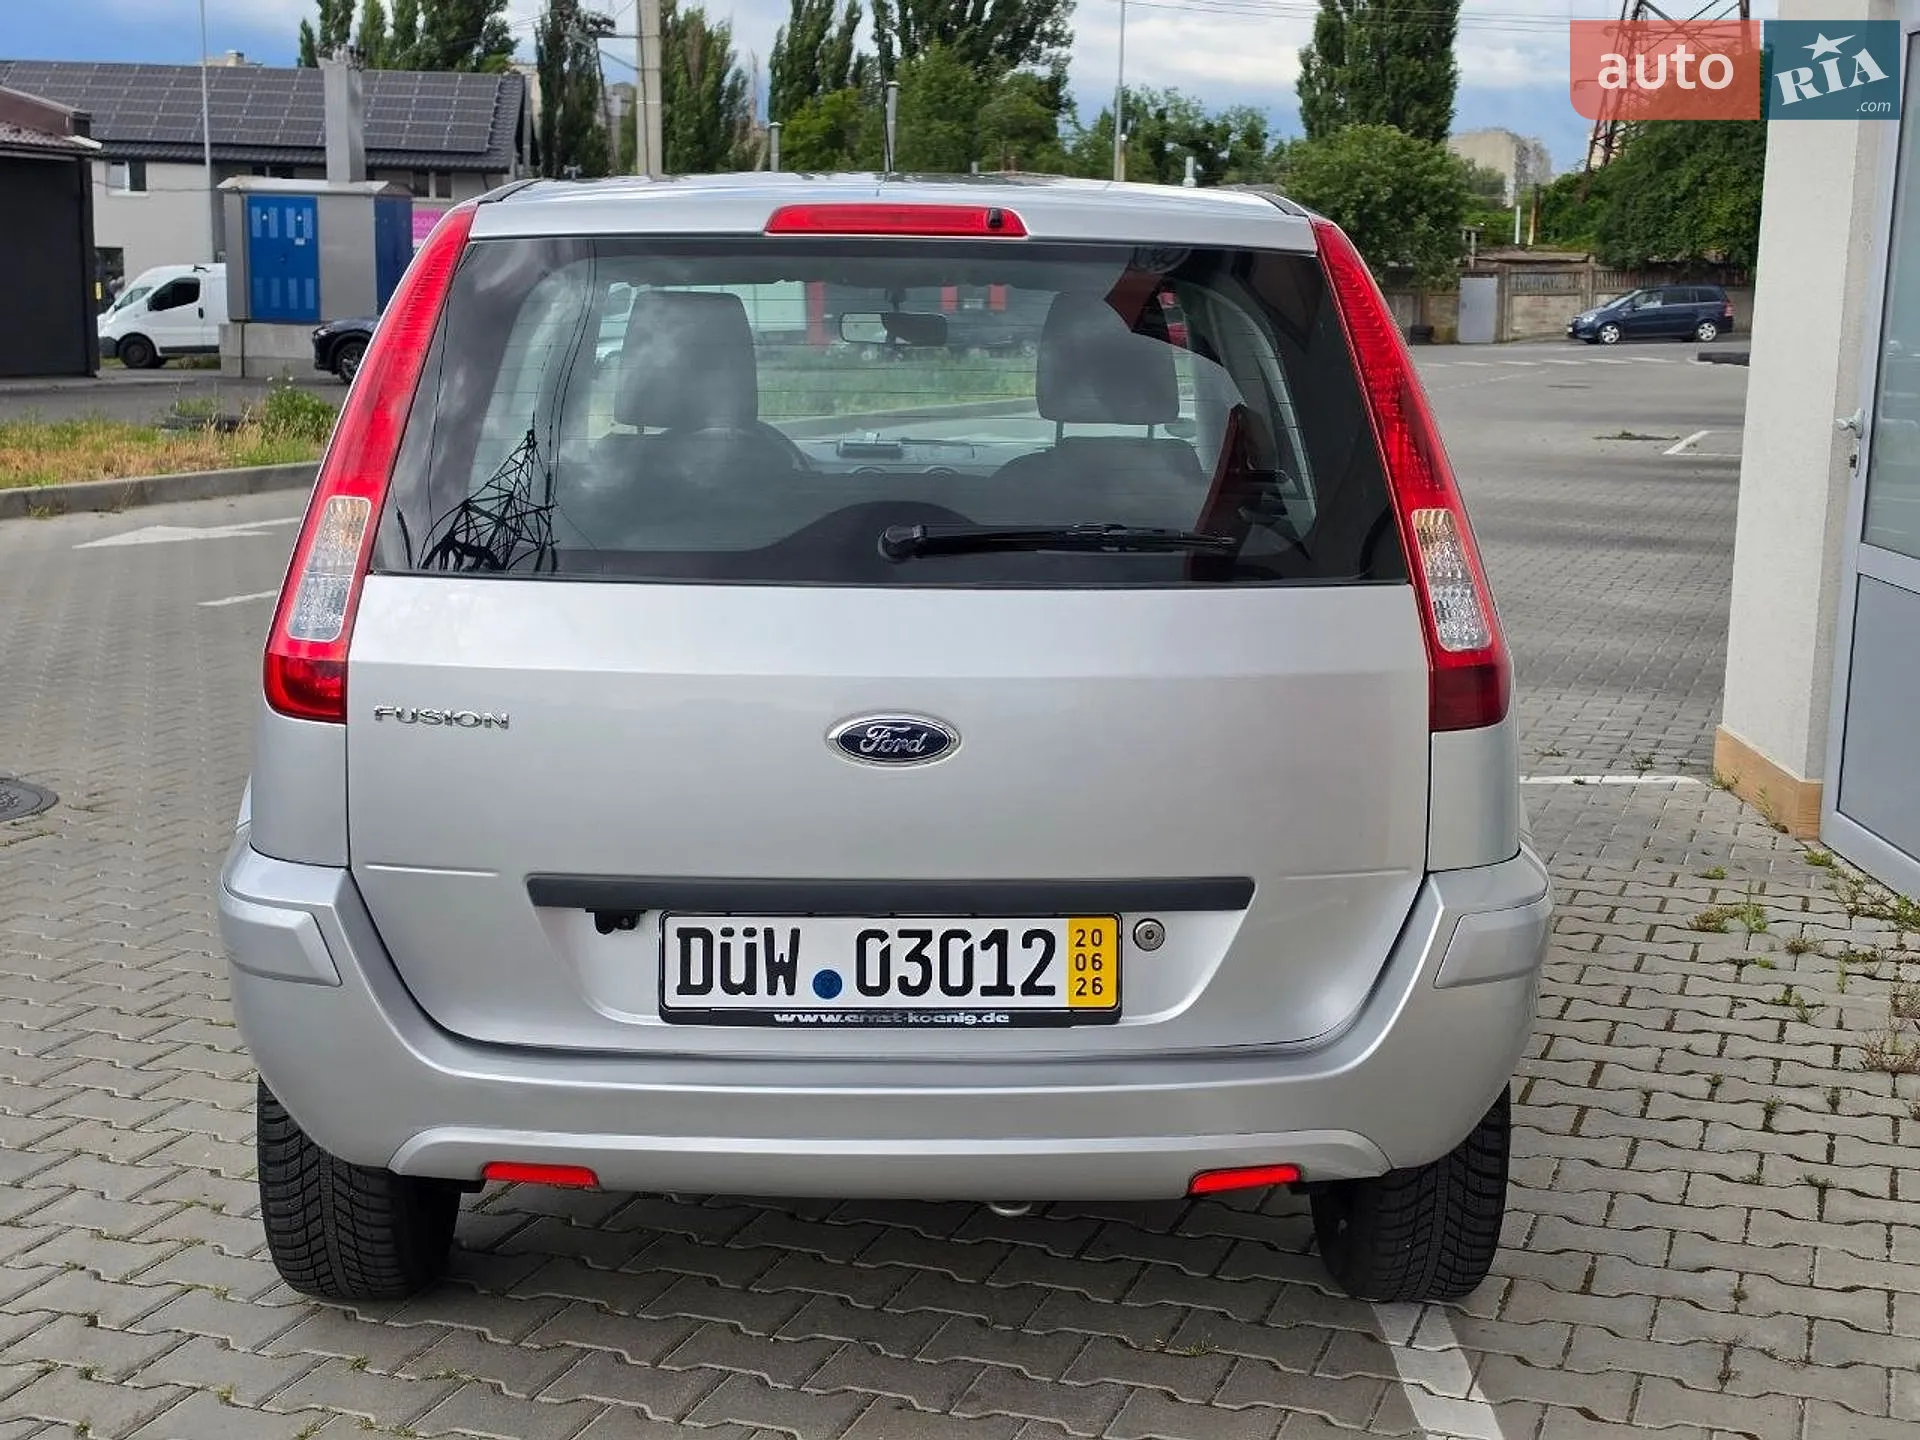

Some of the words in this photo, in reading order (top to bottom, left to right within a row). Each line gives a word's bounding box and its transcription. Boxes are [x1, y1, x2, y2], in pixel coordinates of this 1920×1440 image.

[374, 705, 510, 730] FUSION
[859, 725, 928, 753] Ford
[1075, 928, 1103, 947] 20
[855, 928, 1056, 998] 03012
[1075, 952, 1103, 972] 06
[1075, 976, 1103, 997] 26
